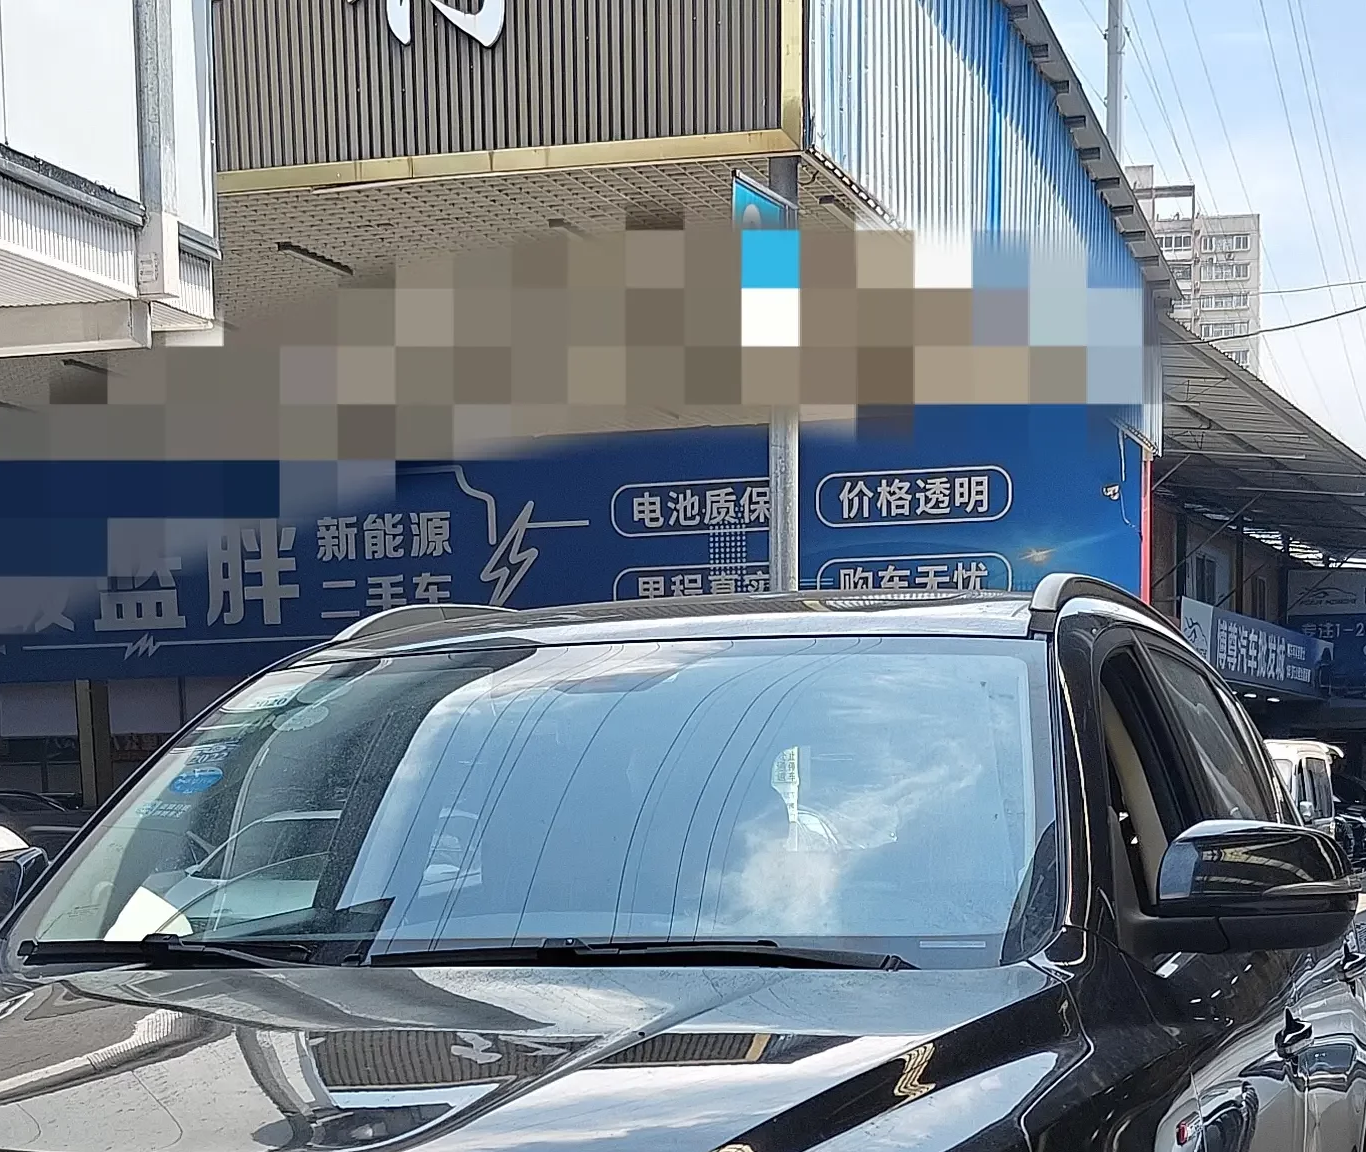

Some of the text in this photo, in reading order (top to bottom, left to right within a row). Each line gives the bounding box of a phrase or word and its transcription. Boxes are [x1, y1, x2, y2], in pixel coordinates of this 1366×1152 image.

[633, 485, 770, 528] 电池质保
[838, 475, 989, 519] 价格透明
[316, 511, 453, 561] 新能源
[321, 572, 452, 618] 二手车
